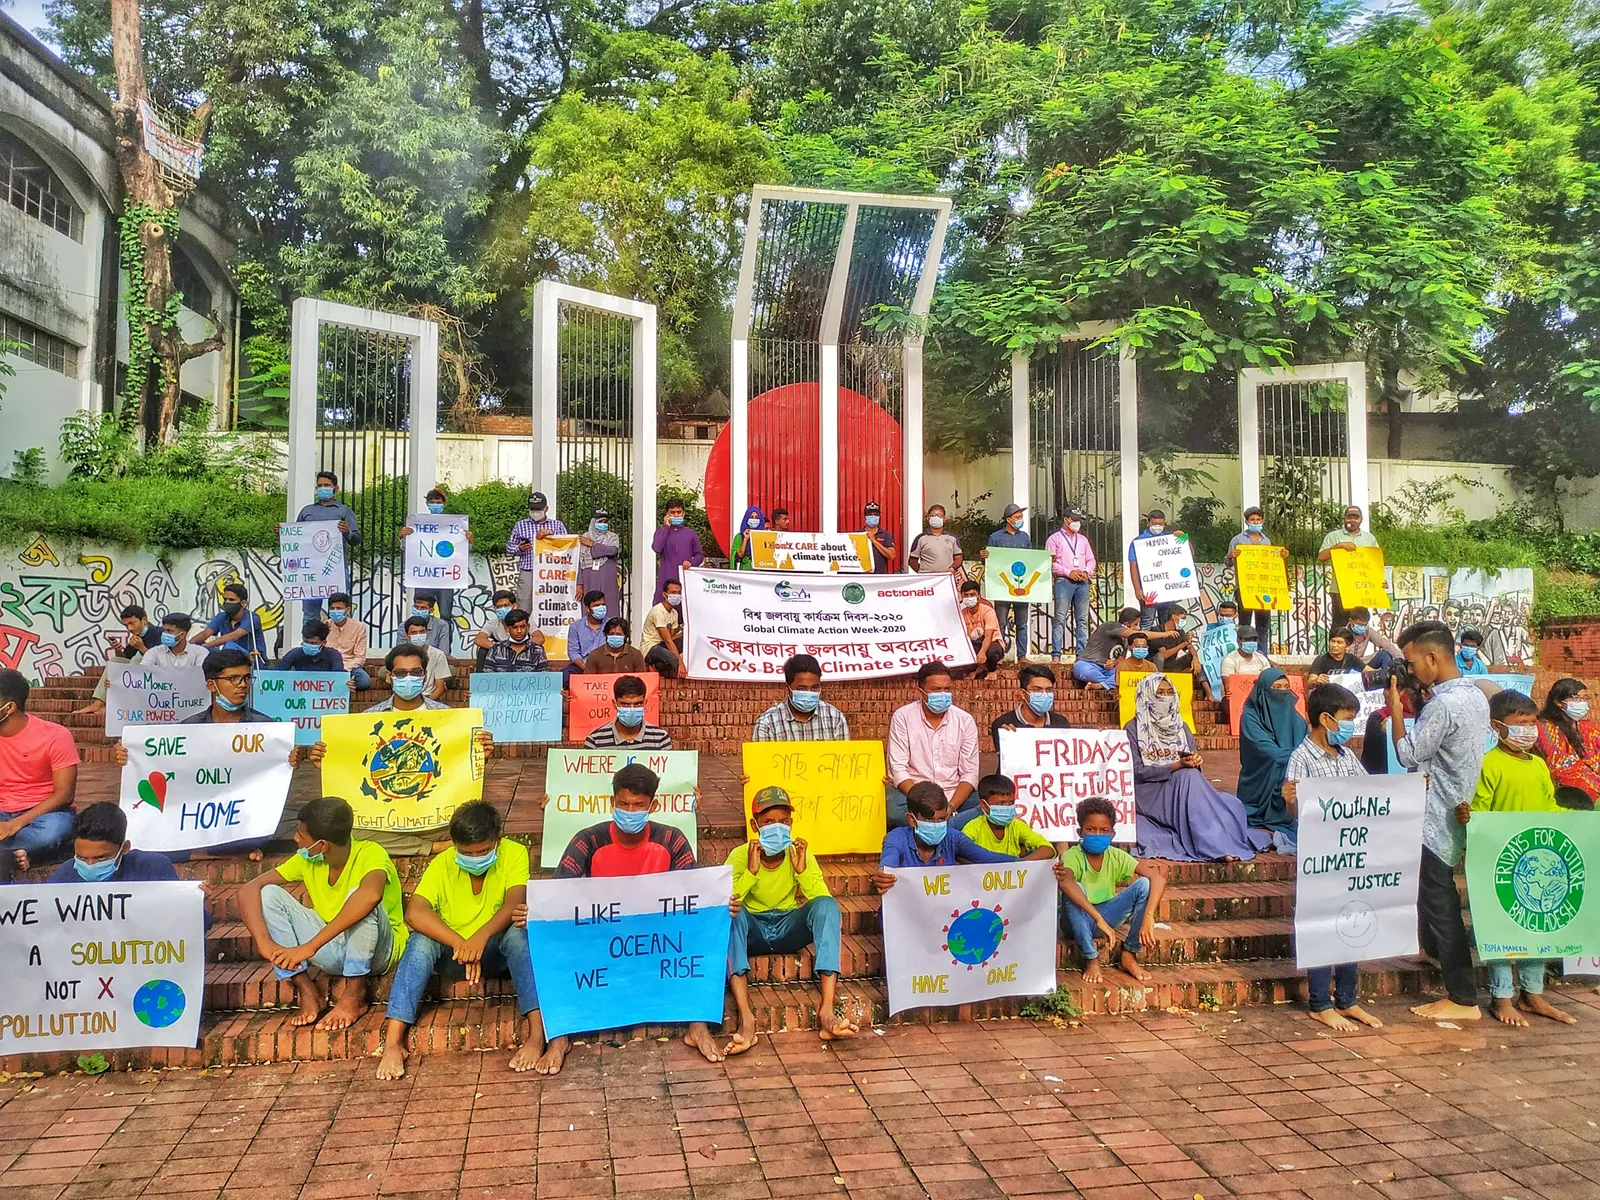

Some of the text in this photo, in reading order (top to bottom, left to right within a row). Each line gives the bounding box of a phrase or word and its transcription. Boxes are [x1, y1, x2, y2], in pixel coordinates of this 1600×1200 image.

[280, 526, 302, 536] RAISE
[414, 523, 460, 535] THERE IS
[282, 542, 299, 552] YOUR
[795, 542, 818, 551] CARE
[820, 543, 846, 552] about
[1146, 538, 1169, 547] HUMAN
[792, 552, 825, 562] climate
[1158, 547, 1182, 556] CHANGE
[1153, 560, 1163, 568] NOT
[284, 573, 316, 582] NOT THE
[538, 568, 567, 581] CARE
[1142, 572, 1170, 582] CLIMATE
[284, 586, 305, 599] SEA
[538, 582, 569, 595] about
[728, 583, 742, 591] Net
[1164, 581, 1191, 591] CHANGE
[538, 598, 579, 612] climate
[537, 613, 575, 629] justice
[743, 608, 762, 621] বিশ্ব
[765, 611, 802, 624] জলবায়ু
[803, 609, 840, 622] কার্যক্রম
[743, 624, 906, 634] Global Climate Action Week-2020
[1203, 628, 1231, 648] THERE
[707, 636, 949, 659] কক্সবাজার জলবায়ু অবরোধ
[1203, 648, 1211, 662] IS
[821, 660, 894, 674] Climate
[262, 679, 335, 692] OUR MONEY
[477, 675, 552, 694] OUR WORLD
[583, 682, 608, 691] TAKE
[285, 697, 347, 710] OUR LIVES
[477, 692, 551, 709] OUR DIGNITY
[593, 693, 608, 701] TO
[117, 709, 144, 721] SOLAR
[505, 708, 550, 724] FUTURE
[588, 707, 610, 719] OUR
[144, 733, 265, 757] SAVE OUR
[1035, 737, 1130, 767] FRIDAYS
[564, 754, 617, 774] WHERE
[650, 755, 669, 774] MY
[772, 752, 872, 782] গাছ লাগান
[196, 767, 232, 785] ONLY
[1059, 768, 1133, 799] FUTURE
[180, 799, 245, 831] HOME
[1339, 826, 1369, 848] FOR
[1302, 851, 1367, 875] CLIMATE
[1495, 829, 1584, 894] FRIDAYS FOR FUTURE
[923, 869, 1028, 896] WE ONLY
[1347, 872, 1402, 892] JUSTICE
[0, 893, 132, 926] WE WANT
[574, 894, 699, 926] LIKE THE
[1507, 899, 1577, 933] BANGLADESH
[29, 939, 185, 966] A SOLUTION
[609, 931, 683, 959] OCEAN
[574, 955, 704, 991] WE RISE
[912, 963, 1018, 994] HAVE ONE
[45, 980, 81, 1000] NOT
[0, 1010, 116, 1040] POLLUTION
